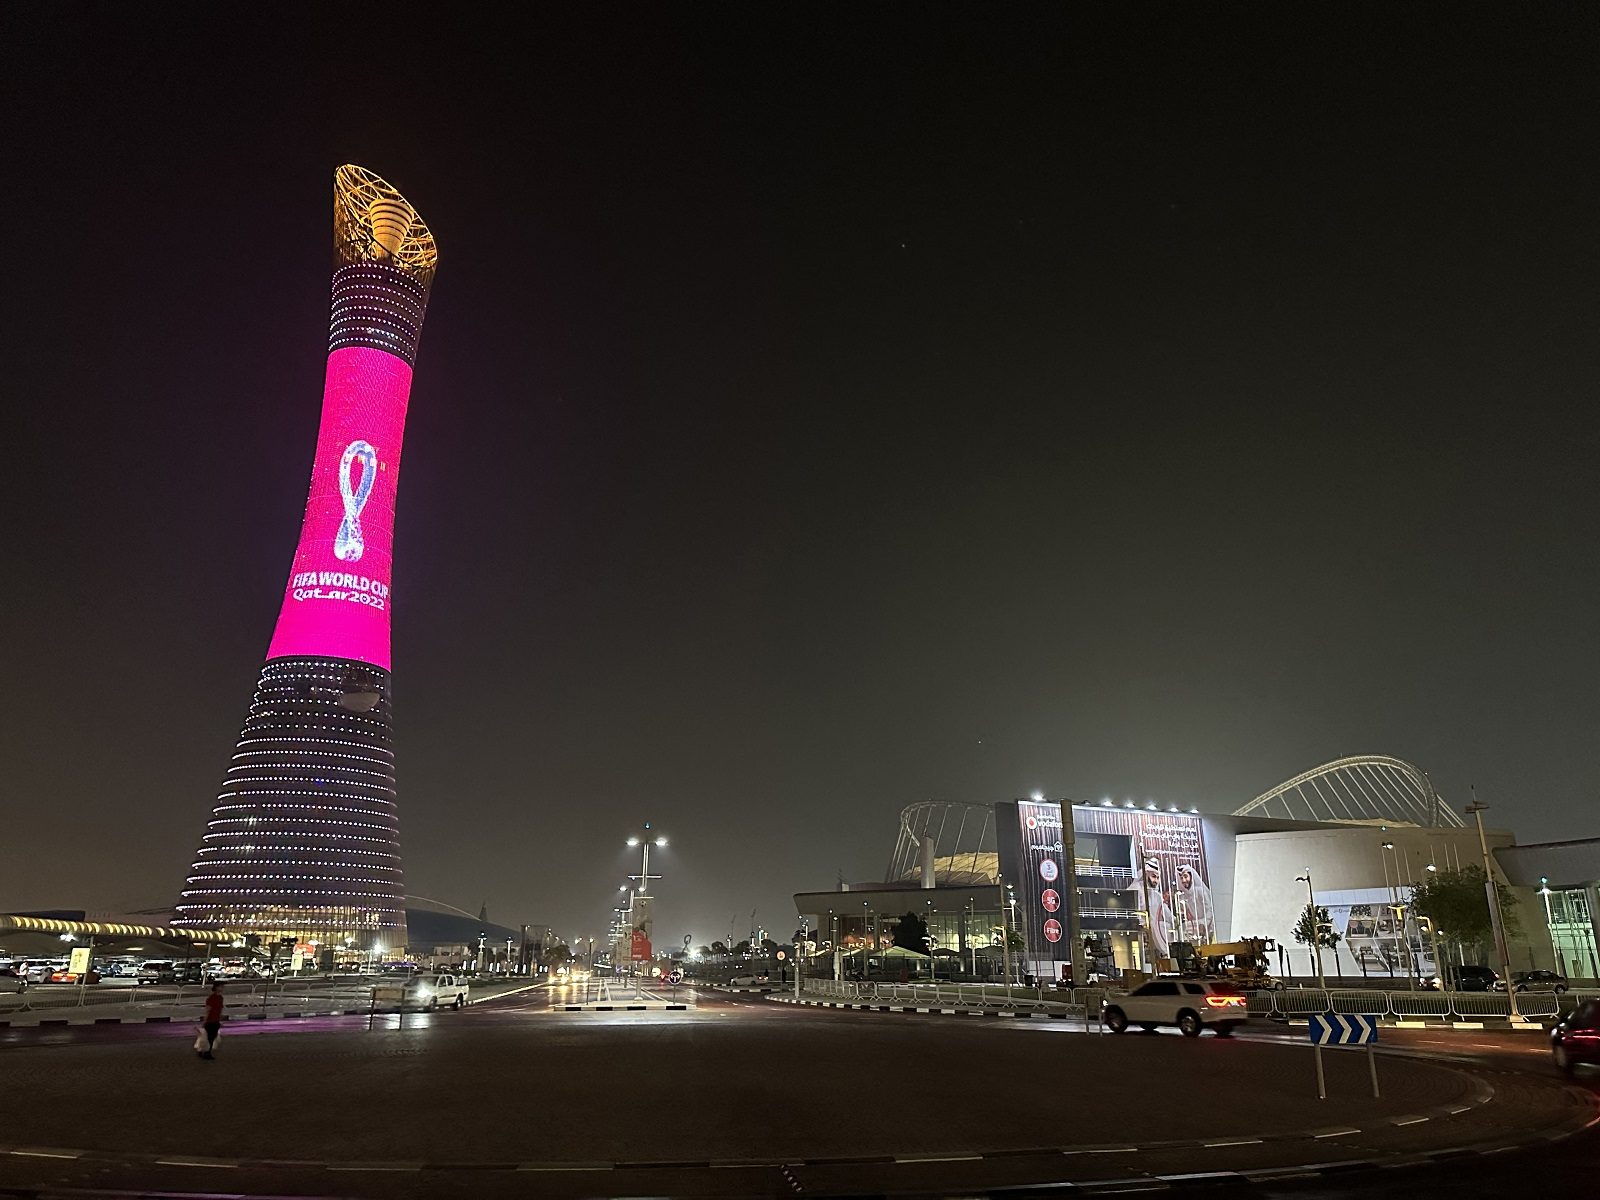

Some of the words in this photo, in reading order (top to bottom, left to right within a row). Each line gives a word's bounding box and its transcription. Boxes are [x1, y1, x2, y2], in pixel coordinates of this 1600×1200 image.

[292, 571, 317, 589] FIFA
[319, 571, 369, 592] WORLD
[371, 580, 389, 599] CUP
[293, 588, 348, 602] Qatar
[347, 591, 385, 611] 2022
